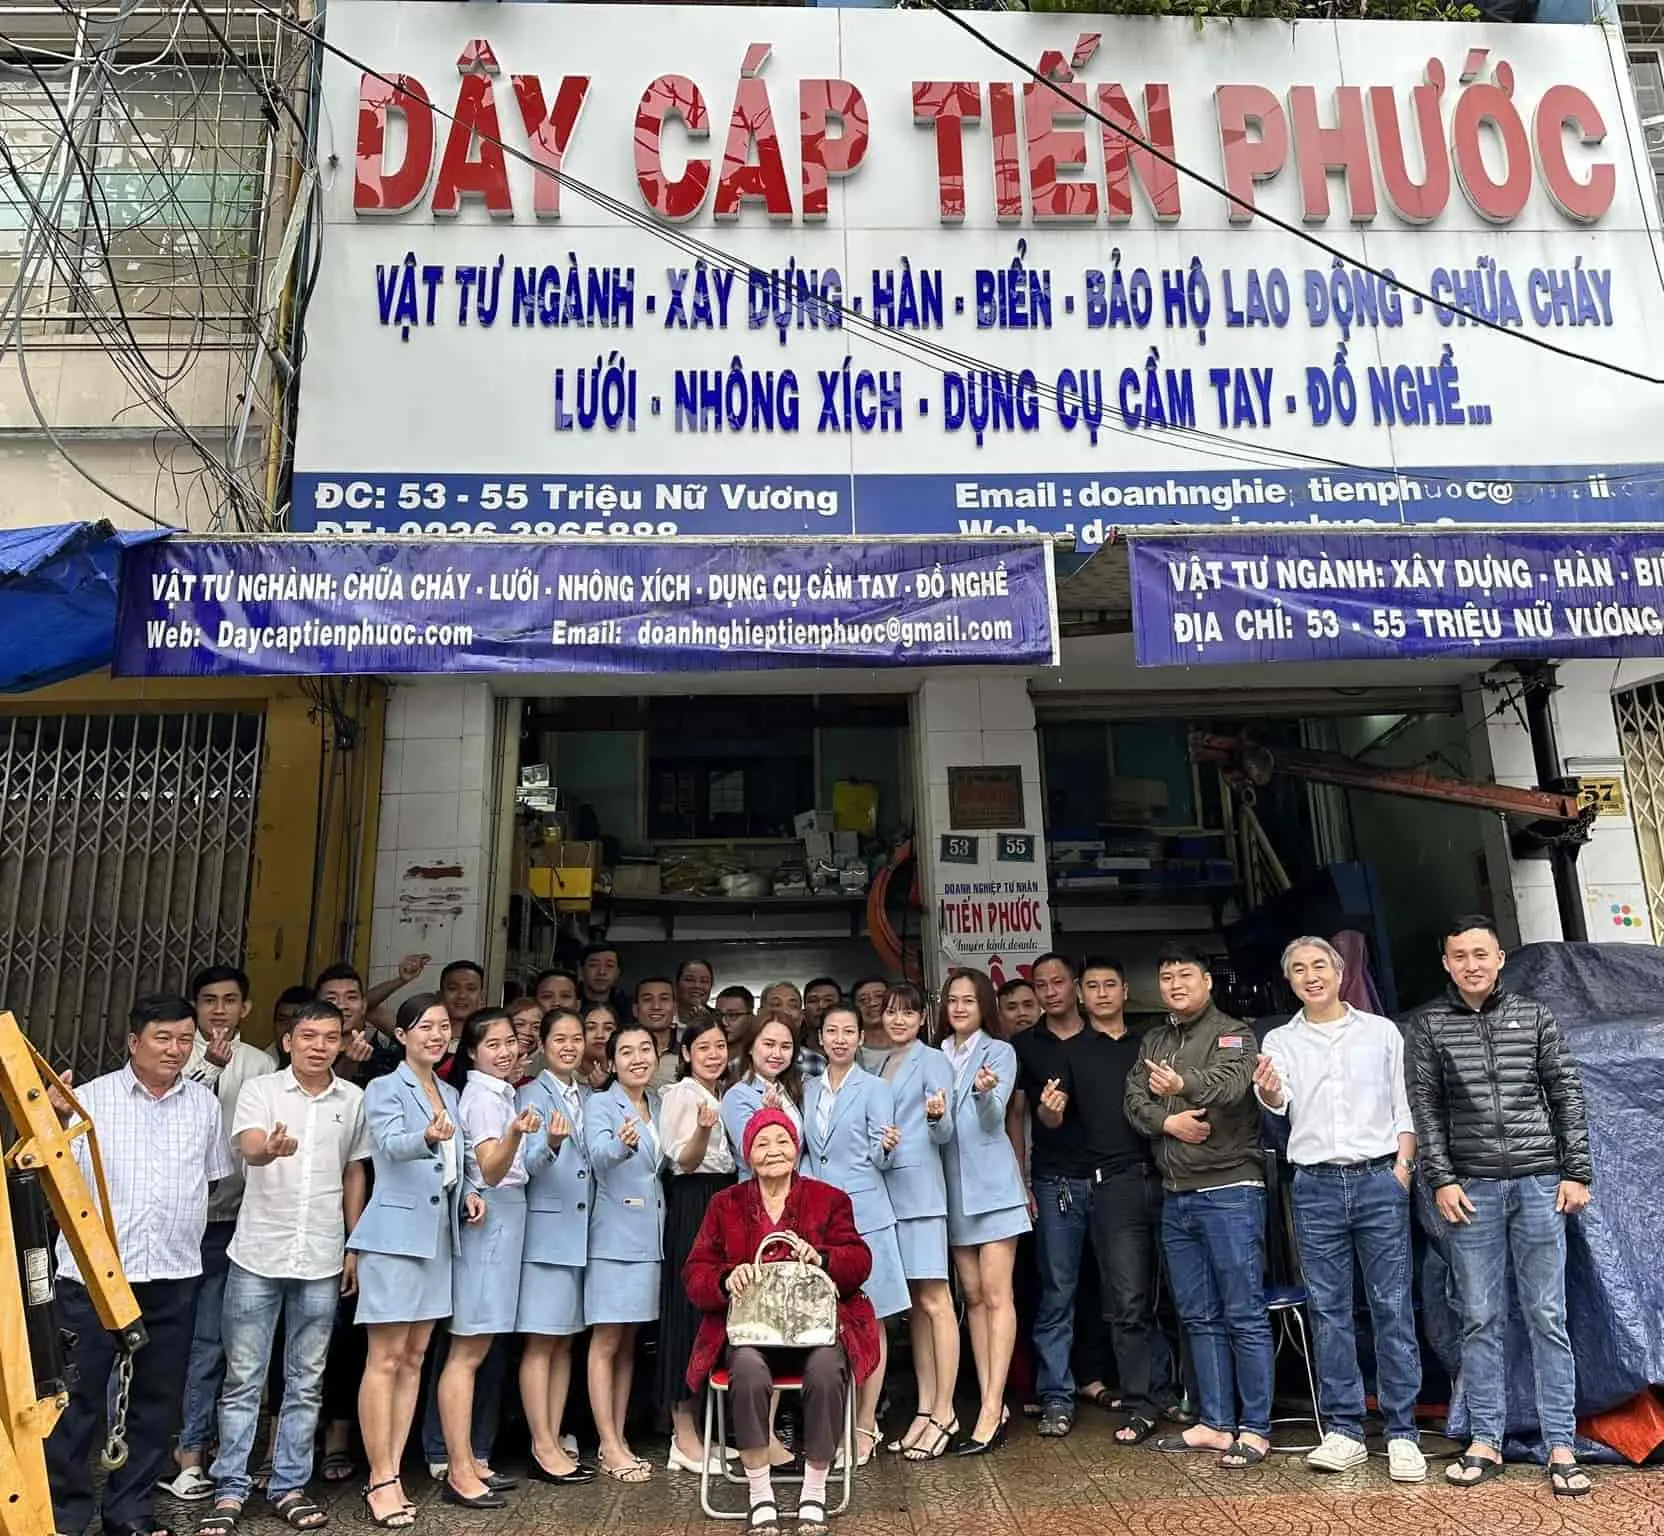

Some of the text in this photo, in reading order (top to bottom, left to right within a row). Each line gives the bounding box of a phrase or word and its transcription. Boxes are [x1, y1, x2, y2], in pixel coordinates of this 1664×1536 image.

[353, 33, 1617, 225] DÂY CÁP TIẾN PHƯỚC
[376, 252, 444, 341] VẬT
[455, 254, 503, 326] TƯ
[512, 252, 634, 328] NGÀNH
[665, 257, 734, 329] XÂY
[748, 257, 842, 344] DỰNG
[872, 255, 942, 329] HÀN
[976, 238, 1052, 329] BIỂN
[1086, 247, 1153, 328] BẢO
[1161, 255, 1210, 345] HỘ
[1222, 268, 1290, 328] LAO
[1304, 256, 1402, 342] ĐỘNG
[1430, 255, 1523, 327] CHỮA
[1527, 255, 1613, 327] CHÁY
[554, 350, 637, 433] LƯỚI
[674, 355, 799, 433] NHÔNG
[817, 355, 902, 433] XÍCH
[942, 368, 1040, 447] DỤNG
[1056, 368, 1103, 445] CỤ
[1119, 346, 1196, 429] CẦM
[1209, 368, 1274, 428] TAY
[1306, 342, 1357, 426] ĐỒ
[314, 482, 386, 509] ĐC:
[398, 482, 446, 510] 53
[480, 482, 528, 510] 55
[543, 482, 641, 517] Triệu
[655, 483, 706, 511] Nữ
[721, 483, 838, 516] Vương
[151, 568, 195, 609] VẬT
[202, 569, 235, 601] TƯ
[237, 567, 337, 601] NGHÀNH:
[343, 566, 404, 601] CHỮA
[410, 567, 472, 601] CHÁY
[490, 566, 539, 601] LƯỚI
[558, 568, 634, 601] NHÔNG
[641, 567, 690, 601] XÍCH
[709, 574, 766, 607] DỤNG
[773, 573, 800, 607] CỤ
[808, 562, 852, 600] CẦM
[858, 573, 897, 599] TAY
[916, 562, 948, 599] ĐỒ
[1169, 555, 1223, 600] VẬT
[1232, 554, 1268, 590] TƯ
[1276, 552, 1385, 589] NGÀNH:
[1390, 552, 1445, 588] XÂY
[1455, 553, 1533, 597] DỰNG
[1553, 550, 1614, 588] HÀN
[1633, 551, 1664, 588] BI
[146, 618, 473, 654] Web: Daycaptienphuoc.com
[552, 616, 1013, 649] Email: doanhnghieptienphuoc@gmail.com
[1174, 611, 1224, 652] ĐỊA
[1235, 598, 1294, 641] CHỈ:
[1306, 608, 1340, 639] 53
[1373, 608, 1406, 638] 55
[1416, 602, 1502, 646] TRIỆU
[1513, 600, 1555, 638] NỮ
[1565, 601, 1664, 638] VƯƠNG
[949, 838, 970, 857] 53
[1005, 838, 1026, 855] 55
[944, 883, 972, 895] DOANH
[945, 894, 1042, 936] TIẾN PHƯỚC
